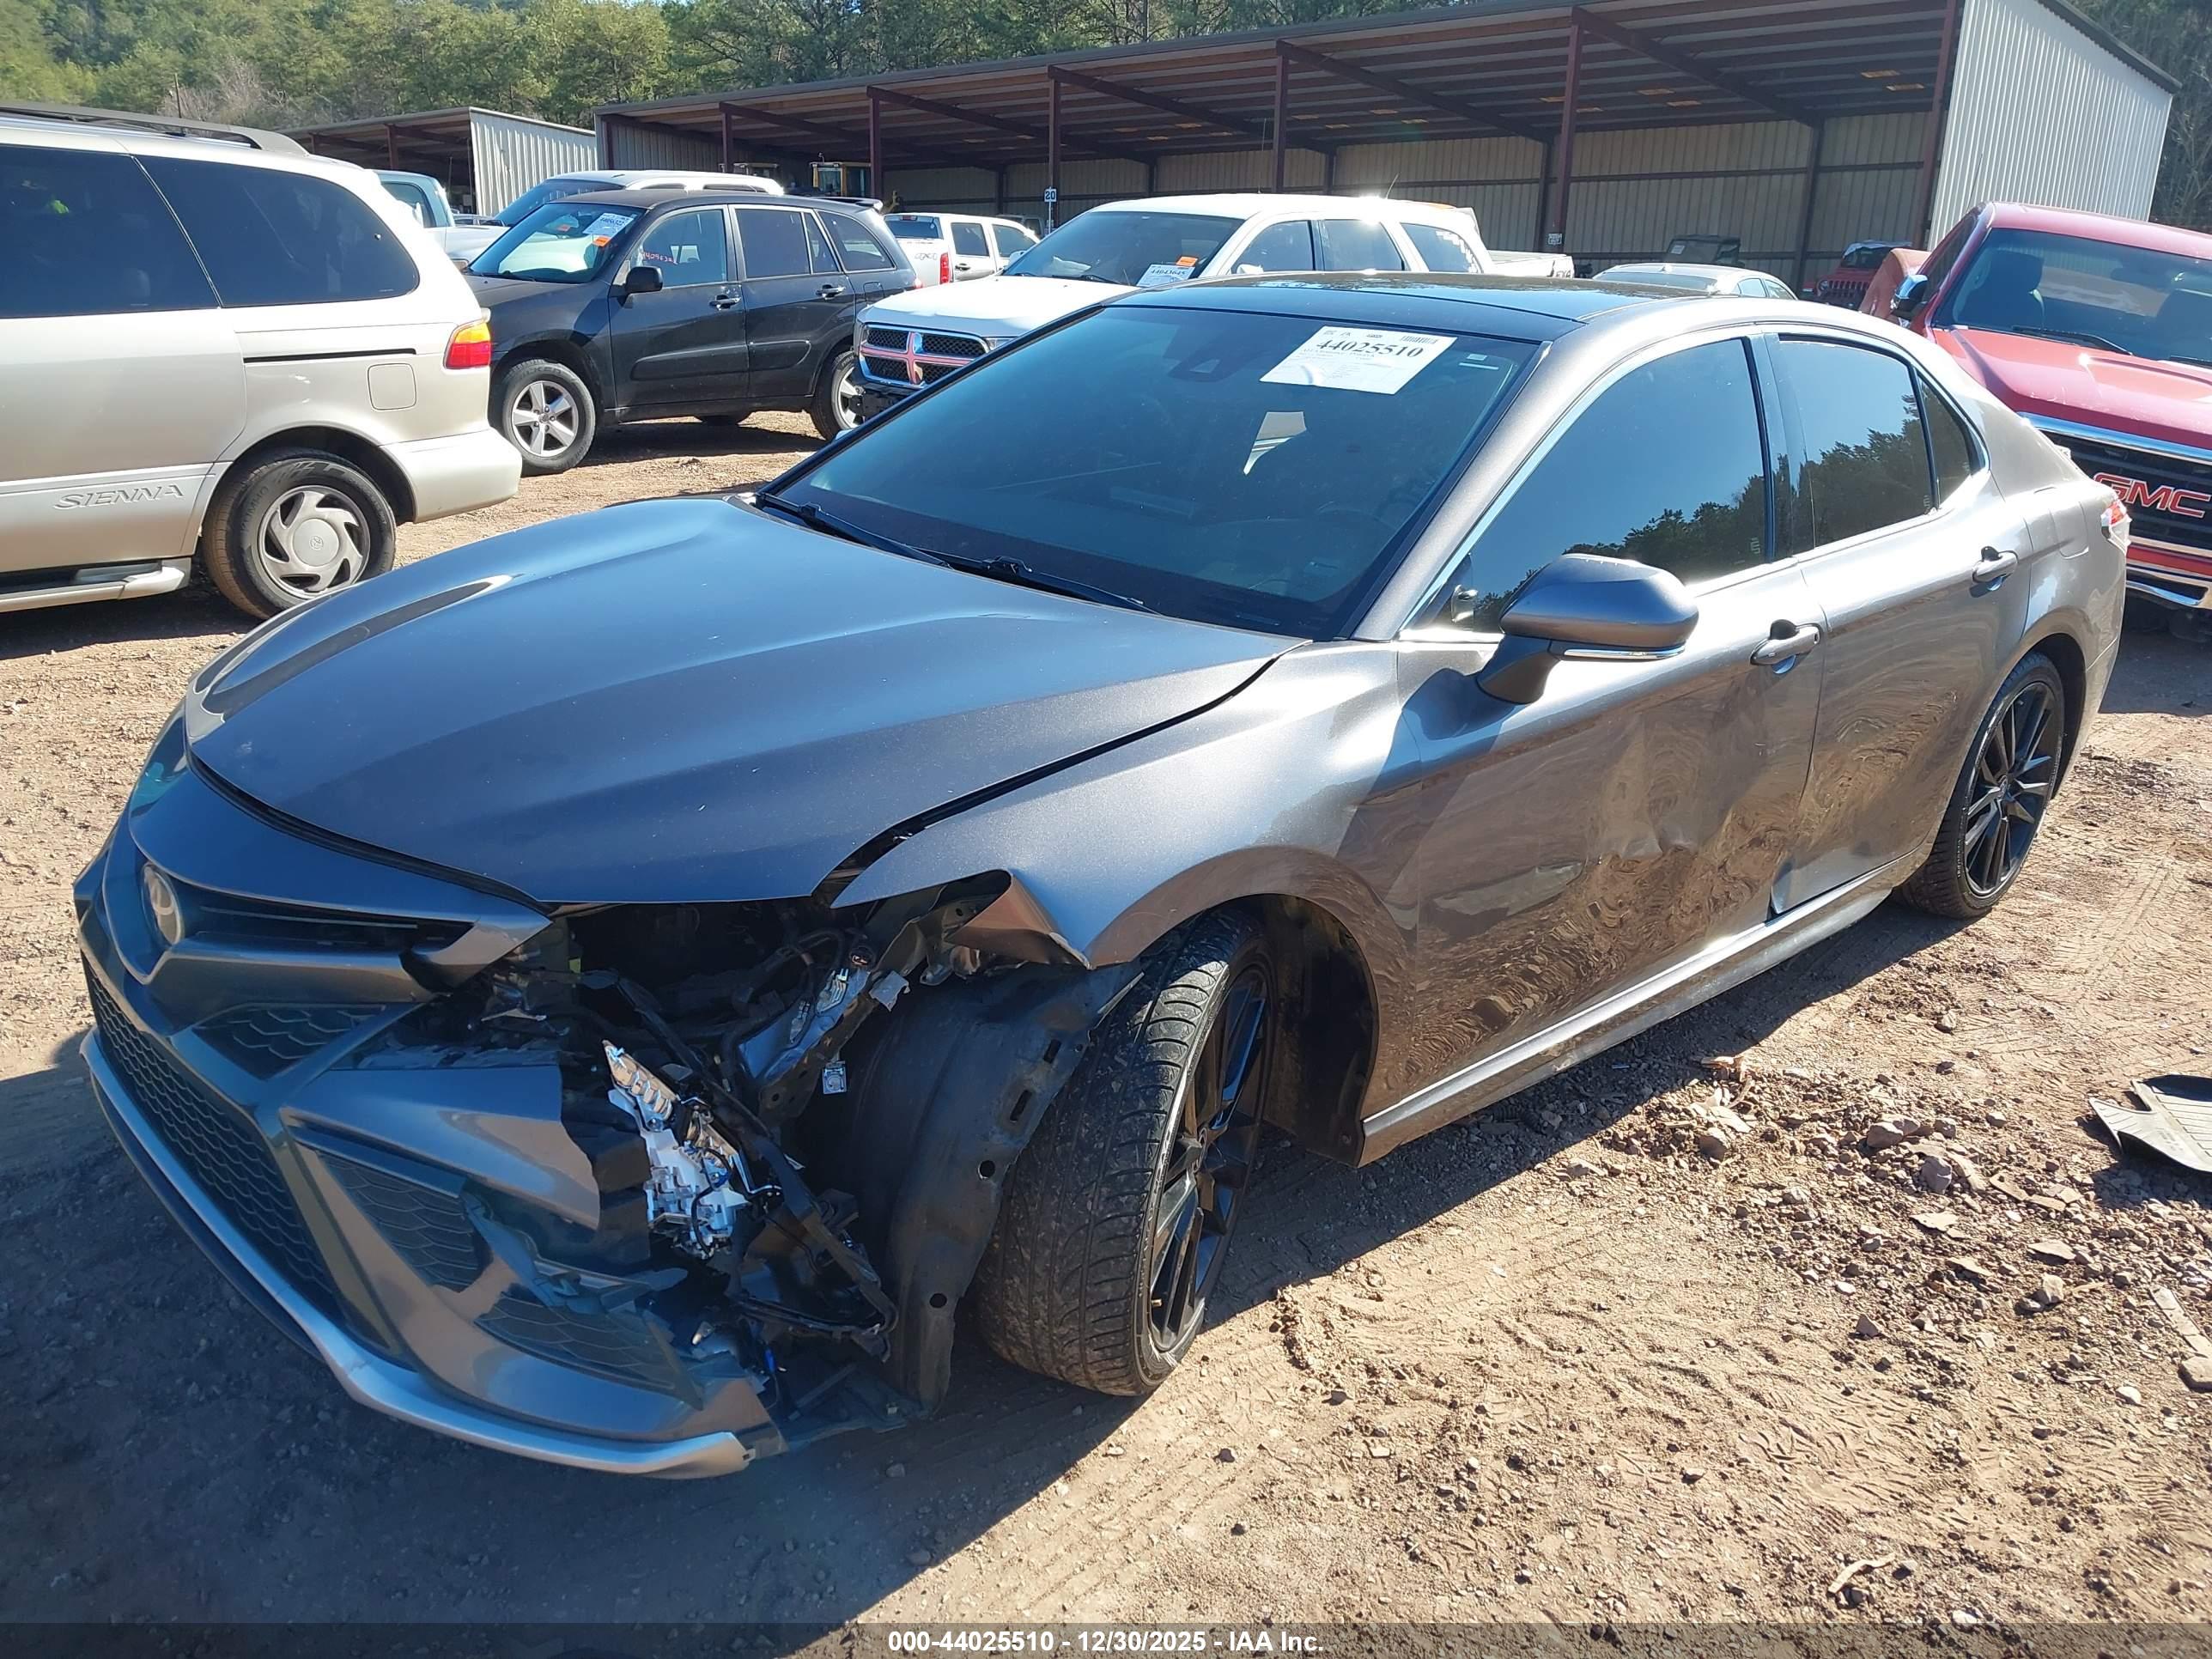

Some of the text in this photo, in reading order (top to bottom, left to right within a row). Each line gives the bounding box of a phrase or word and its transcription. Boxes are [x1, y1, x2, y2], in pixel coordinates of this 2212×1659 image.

[1045, 191, 1056, 200] 20
[1316, 339, 1424, 358] 44025510
[53, 484, 185, 510] SIENNA
[2093, 472, 2212, 519] GMC
